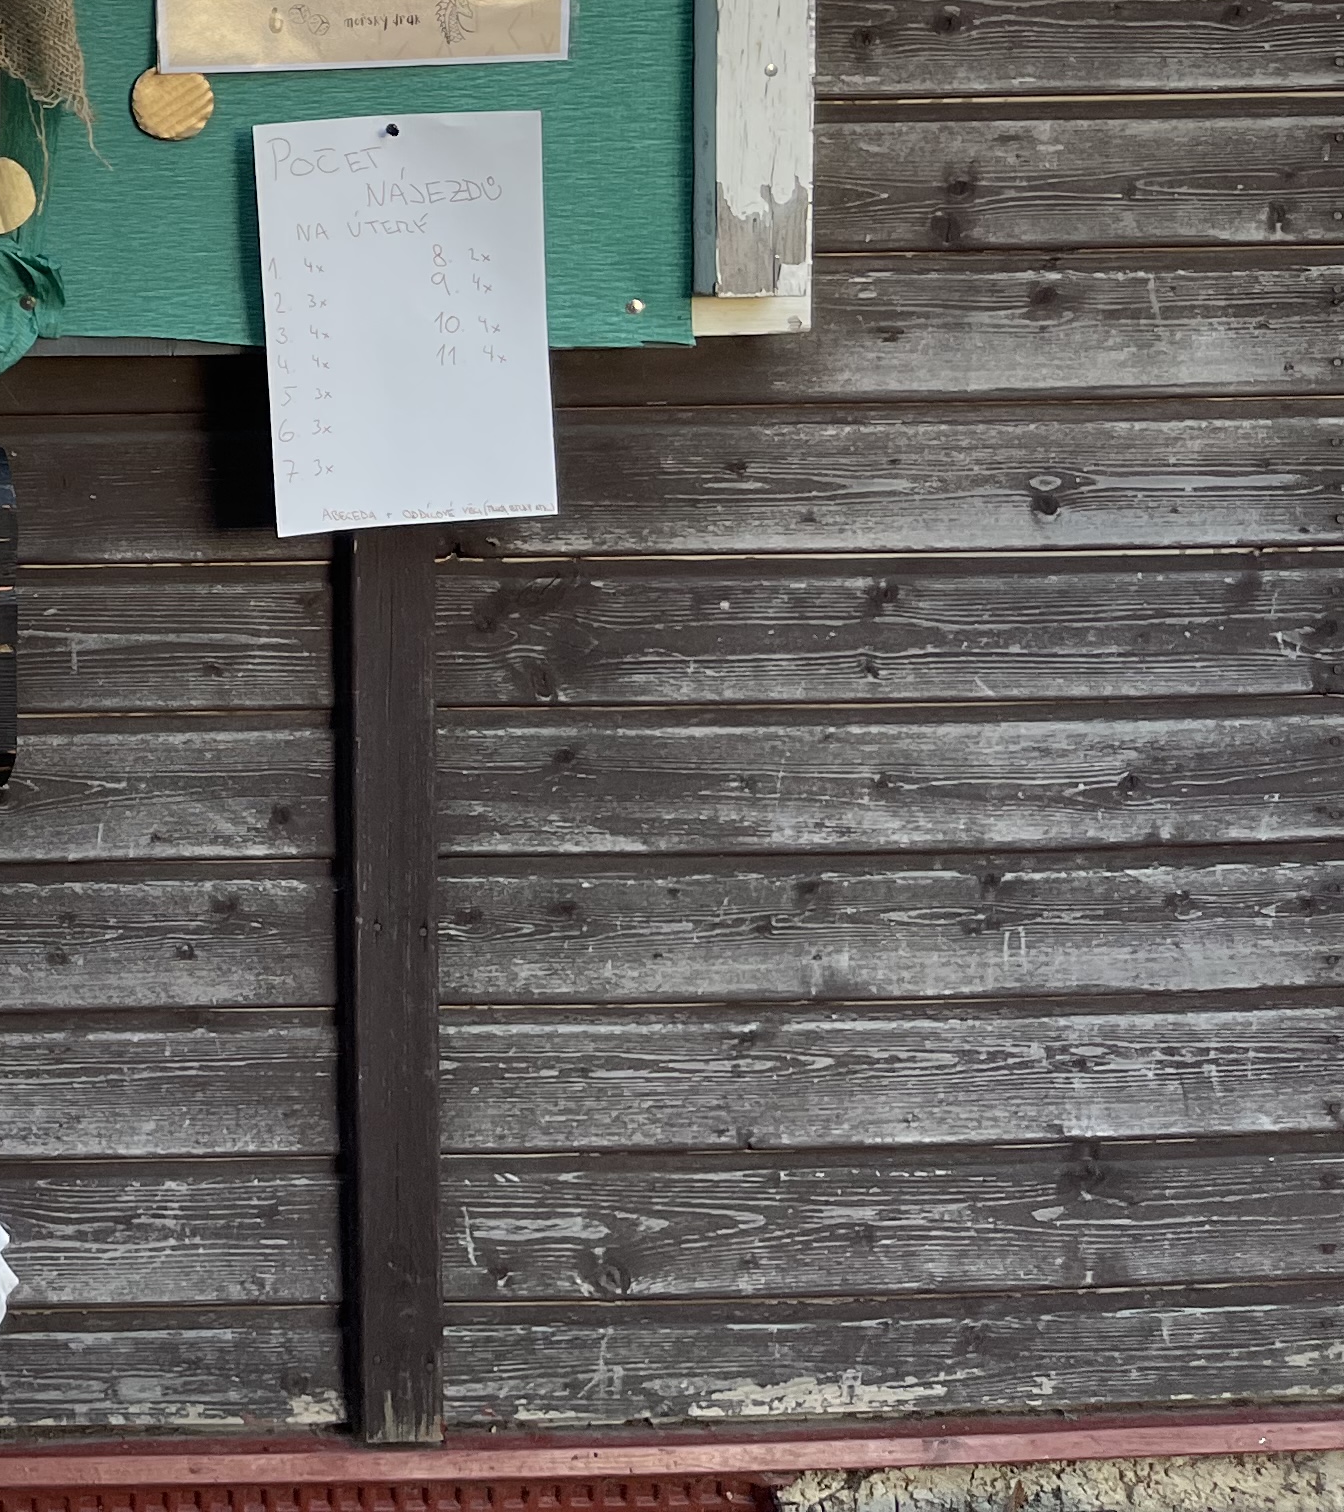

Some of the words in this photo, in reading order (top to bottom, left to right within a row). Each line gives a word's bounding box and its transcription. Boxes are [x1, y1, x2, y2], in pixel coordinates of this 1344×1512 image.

[268, 7, 284, 34] 6
[392, 13, 421, 27] drak
[266, 137, 382, 181] POČET
[366, 166, 503, 207] NÁJEZDŮ
[296, 222, 330, 242] NA
